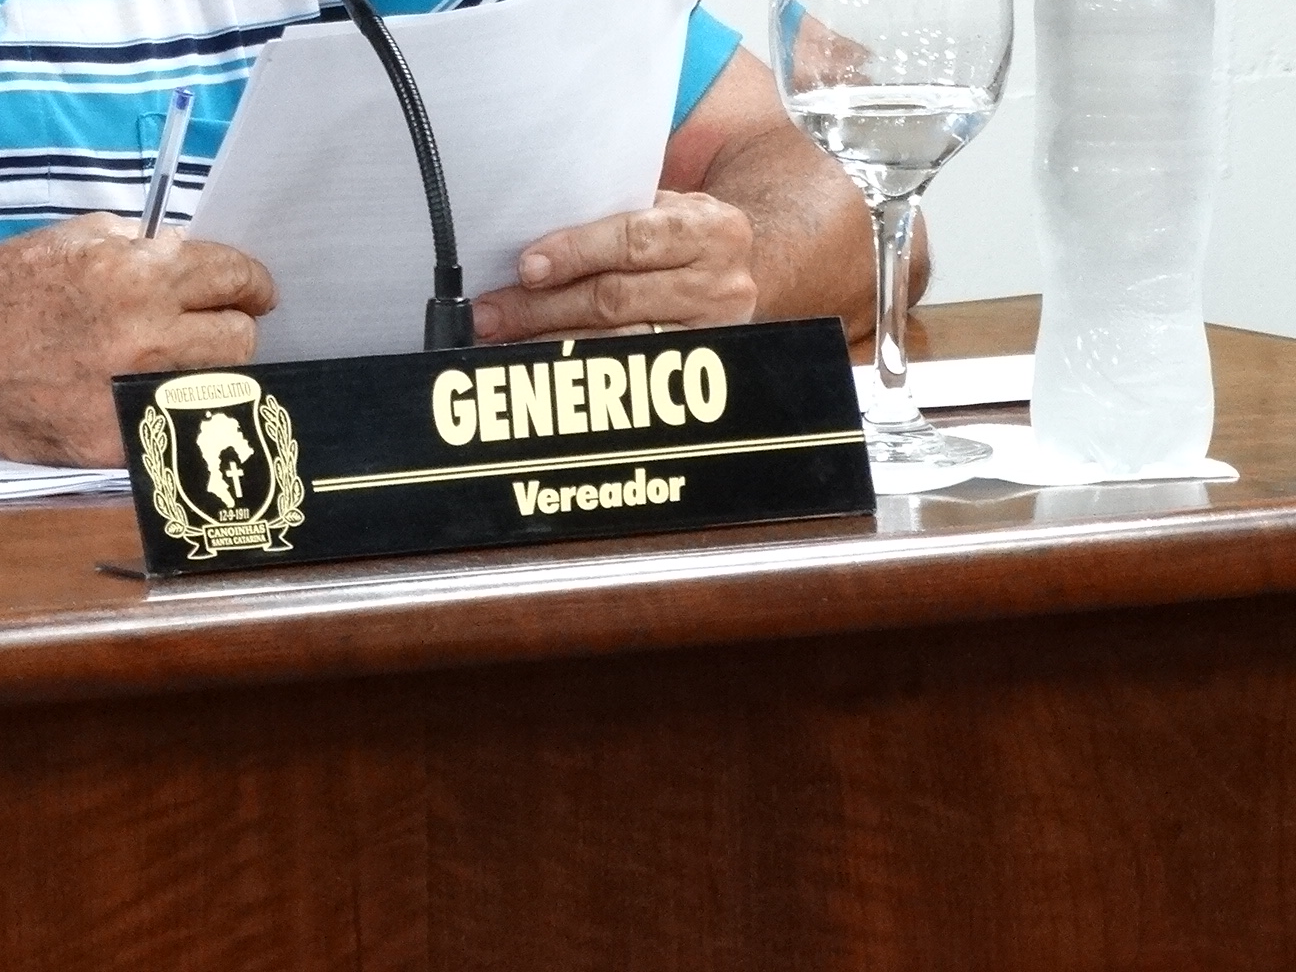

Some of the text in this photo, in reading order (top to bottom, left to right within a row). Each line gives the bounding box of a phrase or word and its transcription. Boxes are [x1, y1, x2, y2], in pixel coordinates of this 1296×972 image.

[164, 381, 252, 404] PODER LEGISLATIVO
[432, 340, 728, 446] GENÉRICO
[512, 468, 686, 516] Vereador
[219, 508, 250, 522] 12-9-1911
[207, 524, 266, 539] CANOINHAS
[211, 534, 267, 547] SANTA CATARINA
